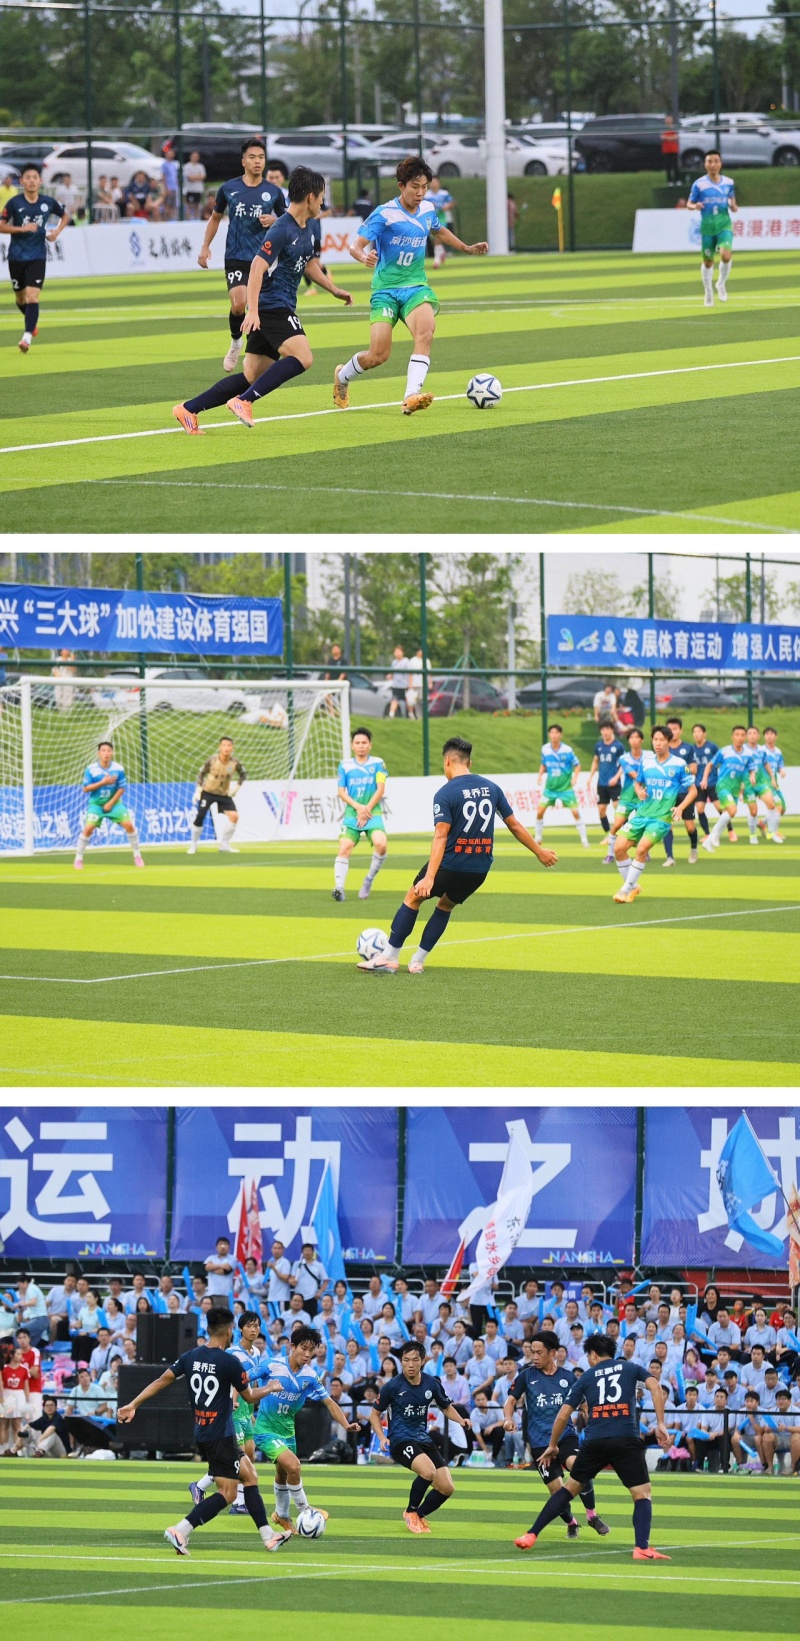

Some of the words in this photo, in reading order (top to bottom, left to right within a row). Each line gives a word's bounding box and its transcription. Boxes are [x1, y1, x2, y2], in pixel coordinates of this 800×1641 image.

[235, 203, 263, 218] 东涌
[397, 251, 414, 266] 10
[227, 270, 243, 284] 99
[287, 315, 303, 331] 19
[115, 603, 268, 644] 加快建设体育强国
[623, 627, 722, 661] 发展体育运动
[462, 787, 490, 799] 麦乔正
[652, 788, 663, 800] 10
[462, 799, 493, 833] 99
[192, 1361, 216, 1374] 麦乔正
[190, 1373, 220, 1408] 99
[597, 1373, 622, 1405] 13
[536, 1393, 563, 1407] 东涌
[277, 1402, 290, 1415] 10
[404, 1404, 427, 1417] 东涌
[403, 1445, 414, 1459] 19
